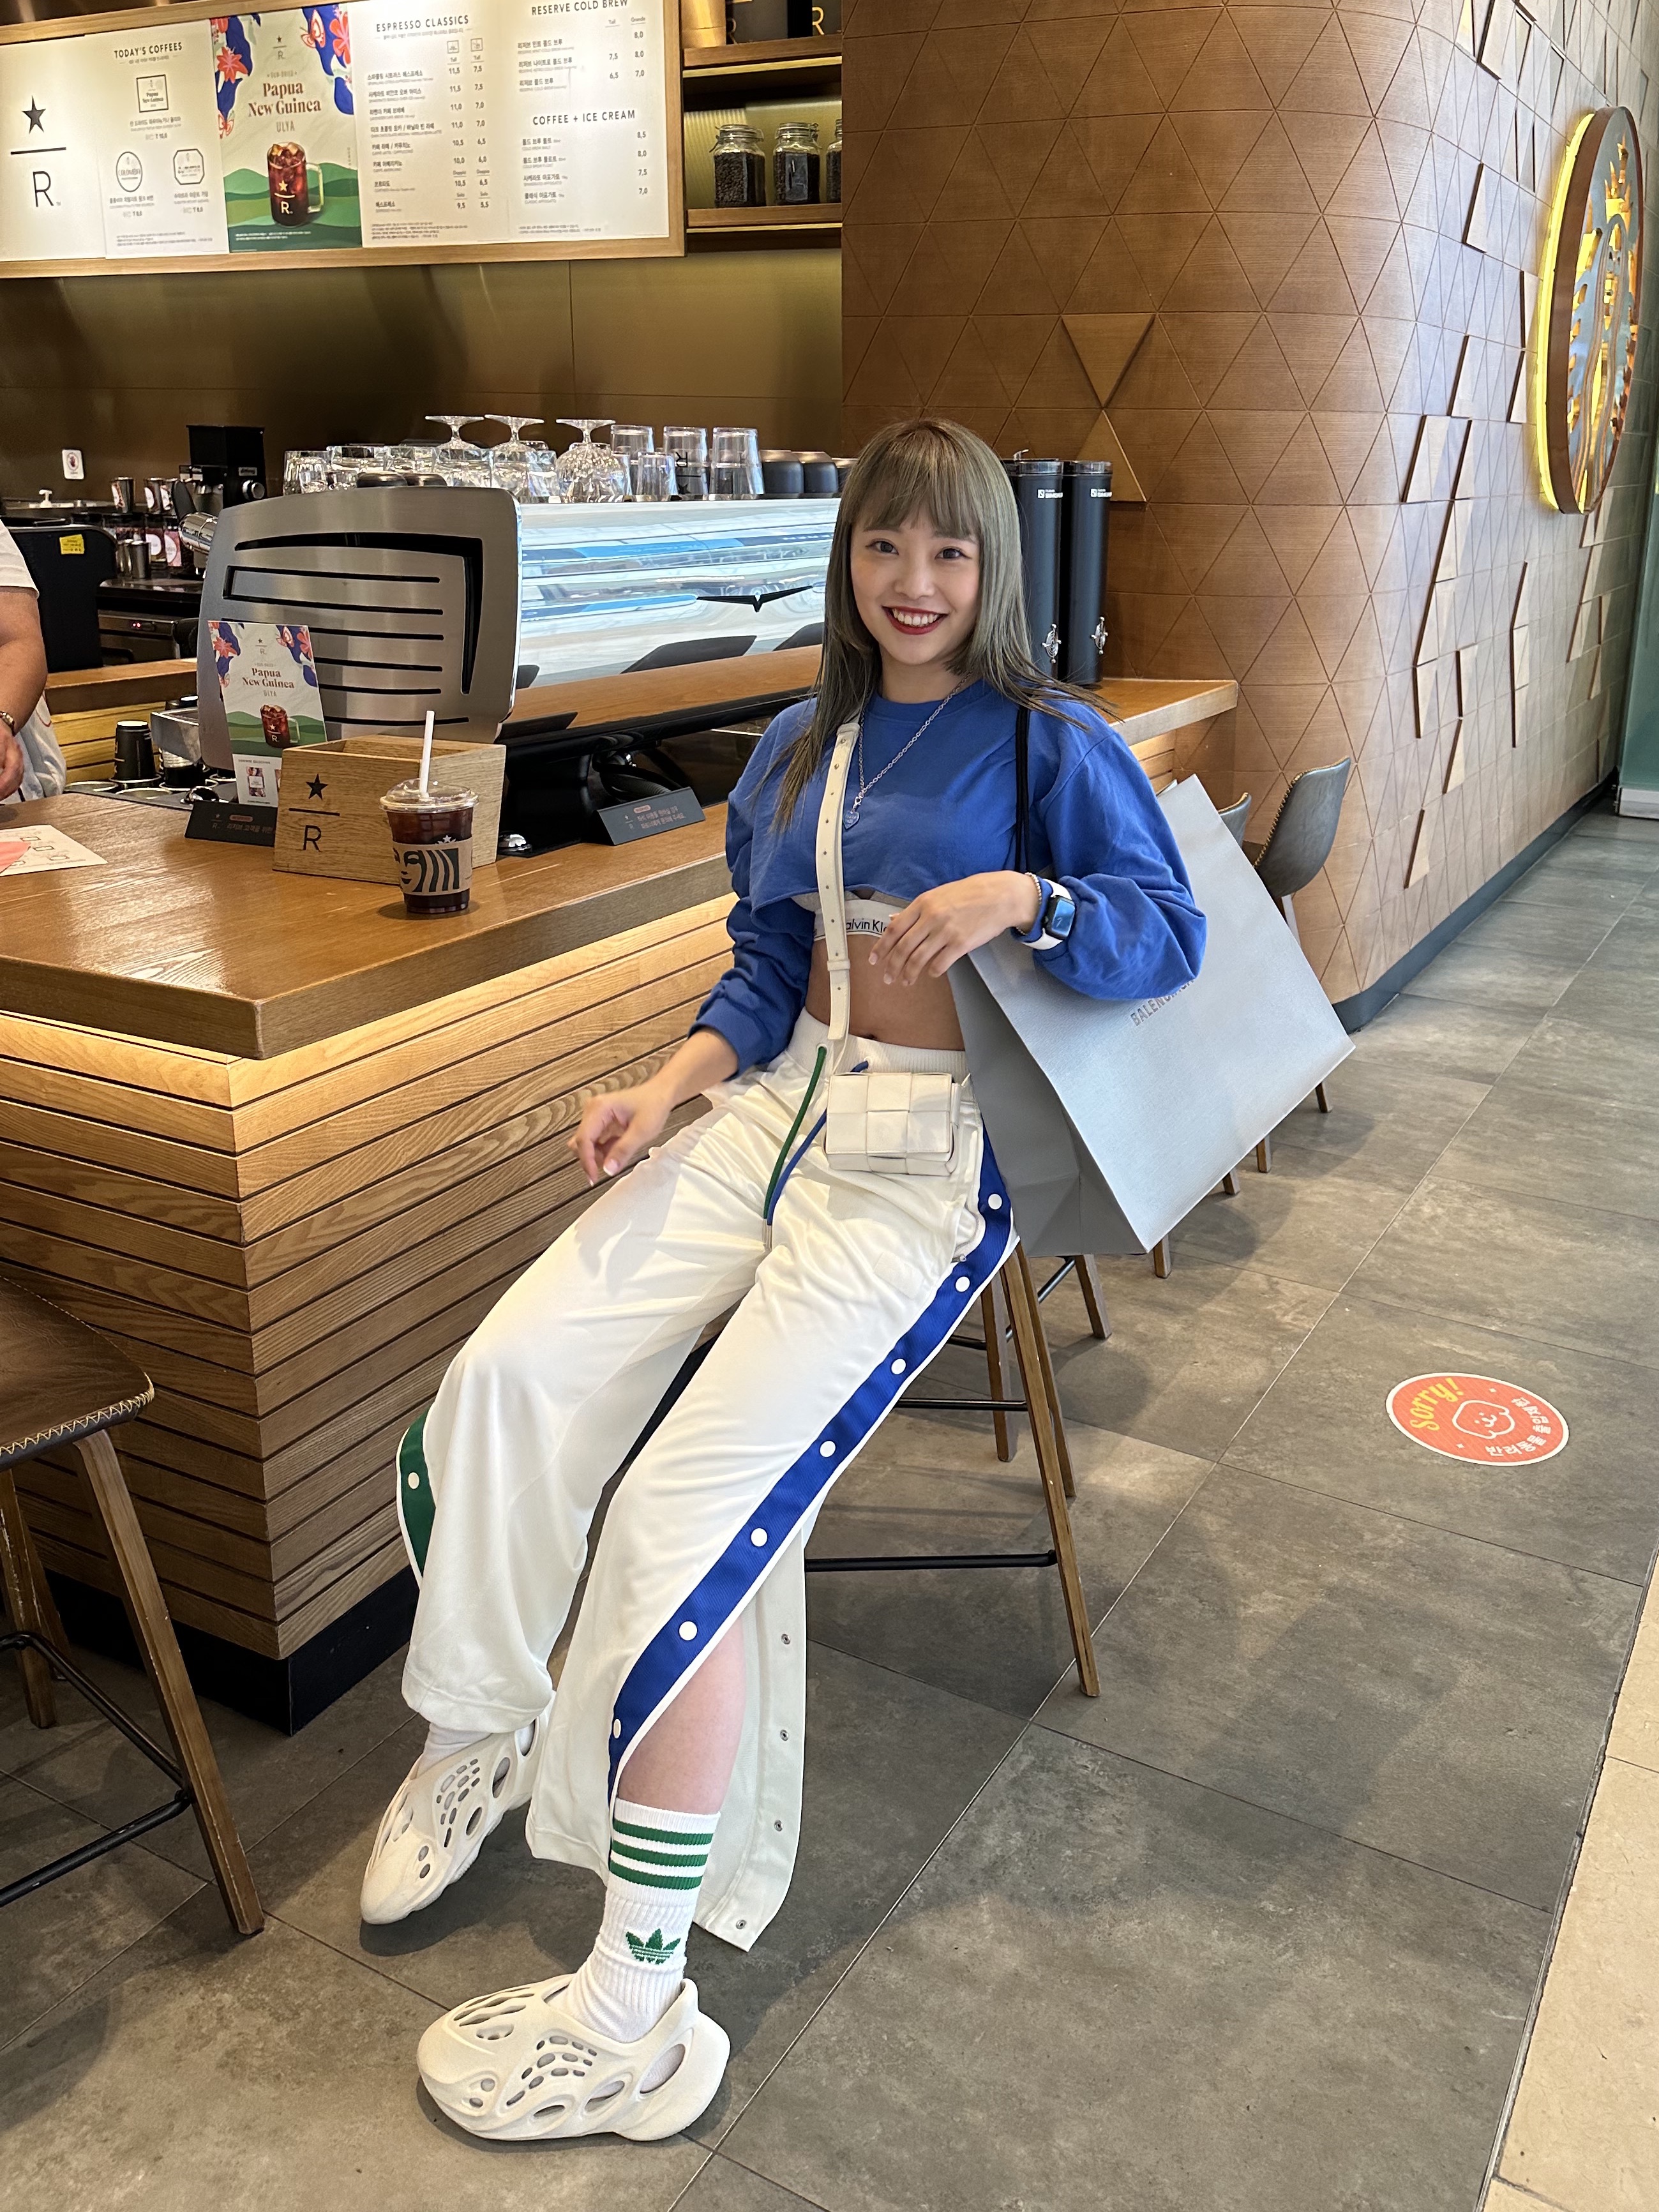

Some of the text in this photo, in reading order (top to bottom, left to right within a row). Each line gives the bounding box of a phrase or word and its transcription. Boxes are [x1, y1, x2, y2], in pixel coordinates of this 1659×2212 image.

[532, 0, 627, 15] RESERVE COLD BREW
[376, 15, 469, 32] ESPRESSO CLASSICS
[114, 42, 183, 58] TODAY'S COFFEES
[263, 82, 303, 98] Papua
[248, 98, 321, 117] New Guinea
[533, 114, 569, 125] COFFEE
[582, 112, 597, 122] ICE
[602, 110, 635, 121] CREAM
[33, 171, 54, 207] R
[281, 201, 290, 214] R
[251, 668, 282, 678] Papua
[242, 677, 295, 689] New Guinea
[303, 825, 322, 852] R
[846, 919, 870, 930] alvin
[1130, 981, 1194, 1026] BALEN
[1409, 1378, 1464, 1431] Sorry!
[1485, 1397, 1551, 1457] 반려동물 출입제한
